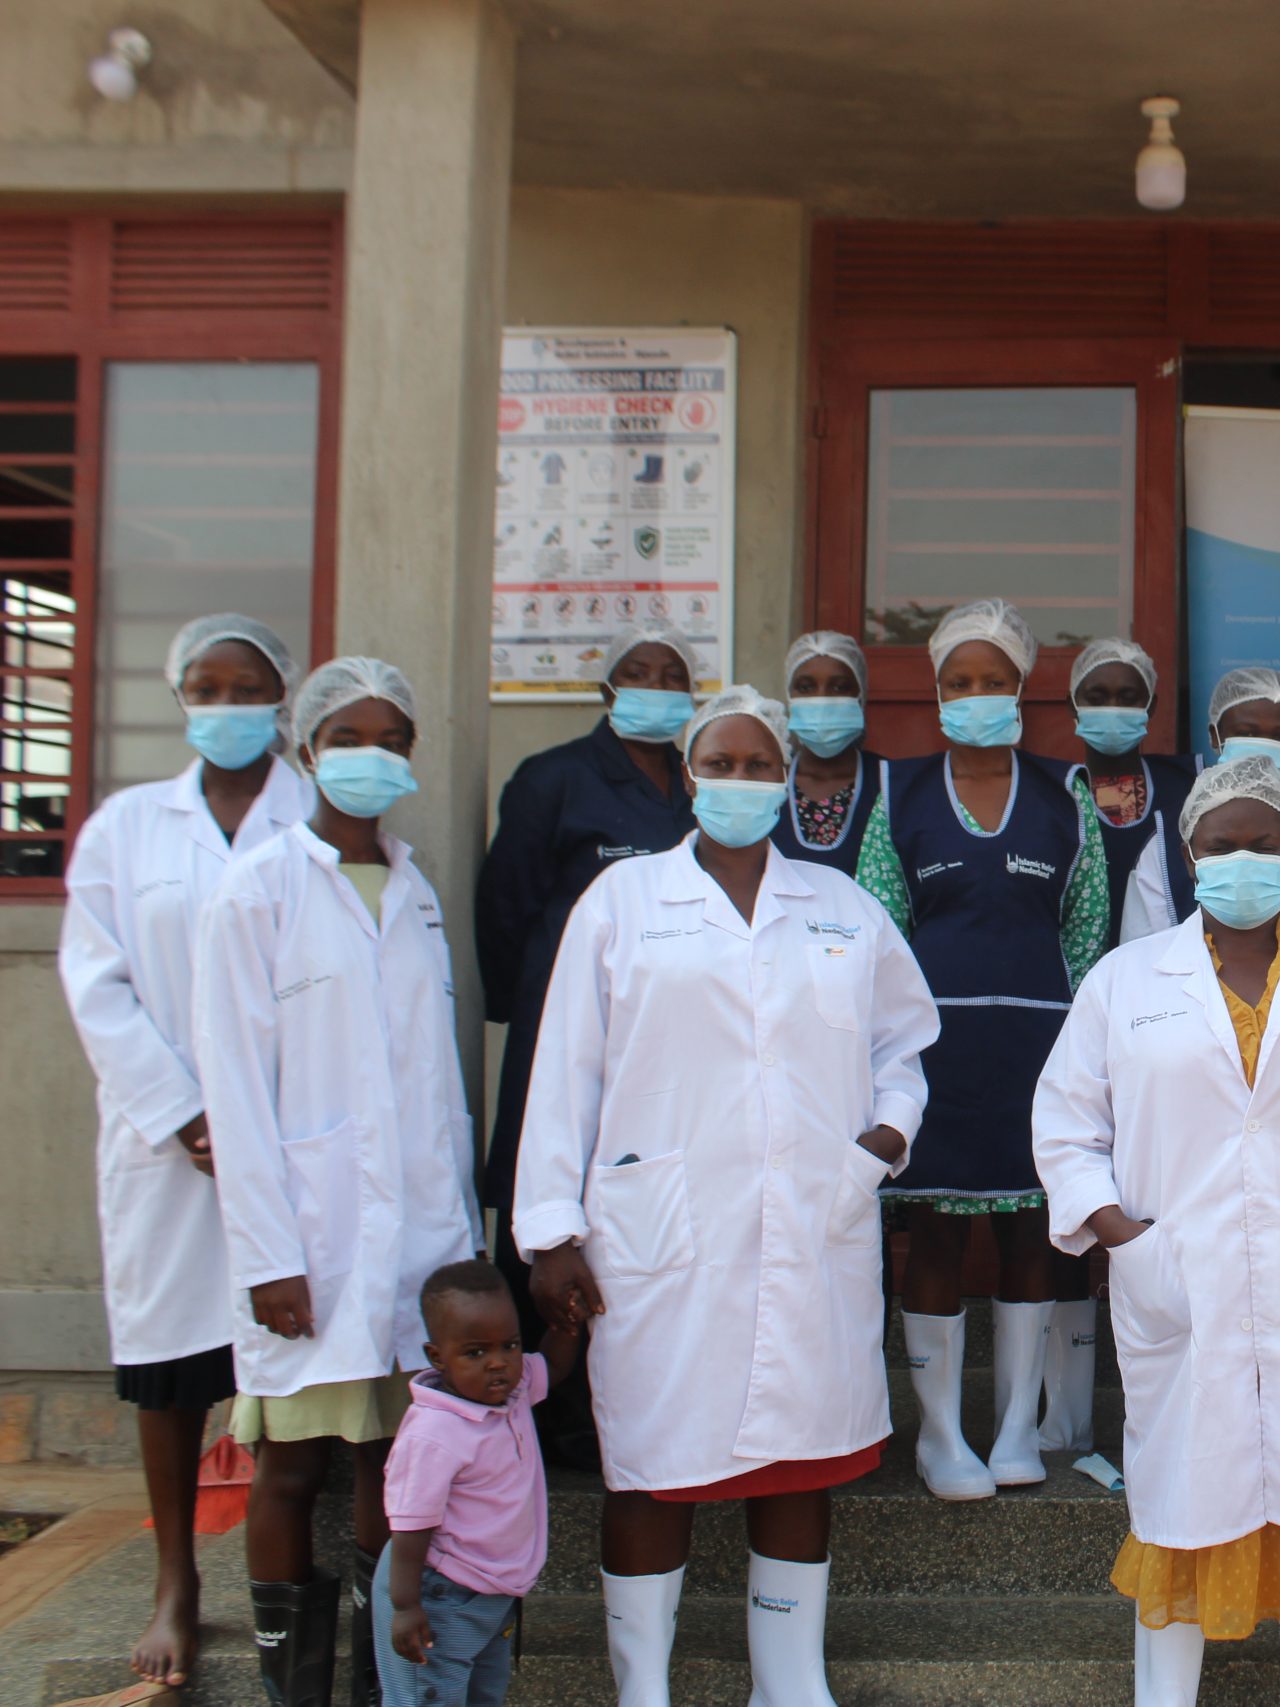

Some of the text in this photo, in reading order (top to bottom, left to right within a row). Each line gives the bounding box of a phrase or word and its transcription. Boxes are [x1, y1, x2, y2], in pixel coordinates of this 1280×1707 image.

[500, 371, 715, 392] OOD PROCESSING FACILITY
[532, 396, 675, 416] HYGIENE CHECK
[543, 416, 662, 432] BEFORE ENTRY
